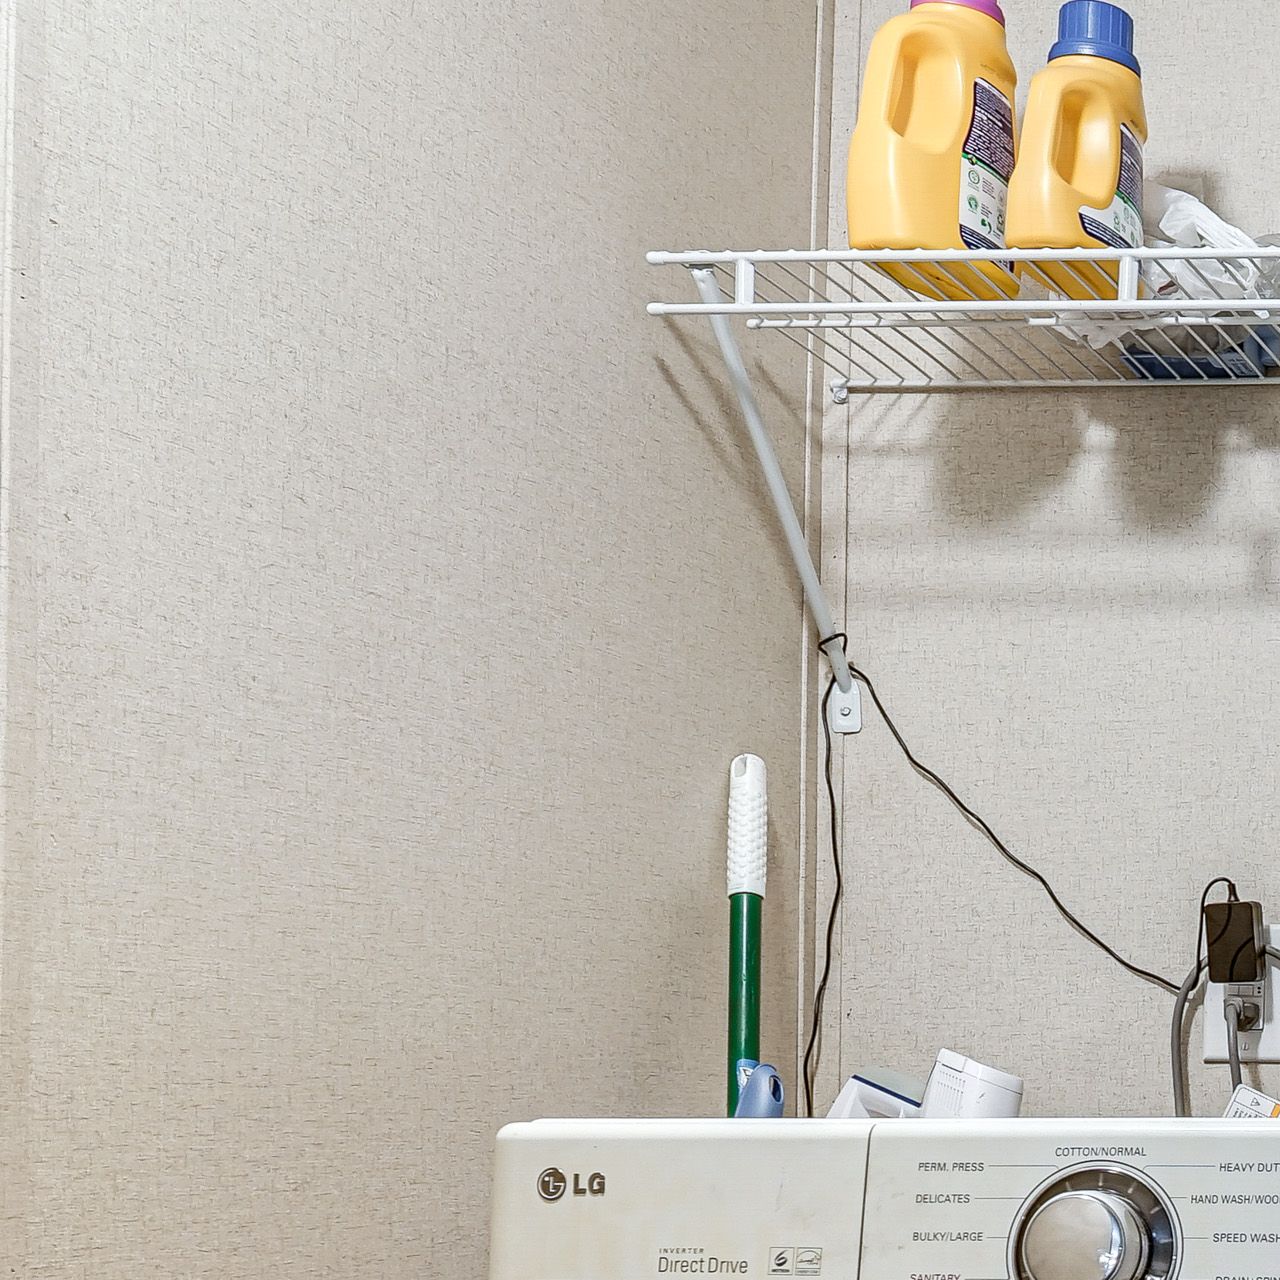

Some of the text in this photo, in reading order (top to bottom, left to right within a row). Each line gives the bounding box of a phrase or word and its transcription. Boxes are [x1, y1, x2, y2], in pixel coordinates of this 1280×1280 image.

[1055, 1147, 1147, 1157] COTTON/NORMAL
[918, 1162, 985, 1172] PERM. PRESS
[1219, 1163, 1254, 1172] HEAVY
[573, 1173, 605, 1195] LG
[915, 1194, 970, 1204] DELICATES
[1190, 1194, 1219, 1204] HAND
[912, 1232, 983, 1242] BULKY/LARGE
[1212, 1233, 1247, 1243] SPEED
[658, 1256, 748, 1274] Direct Drive
